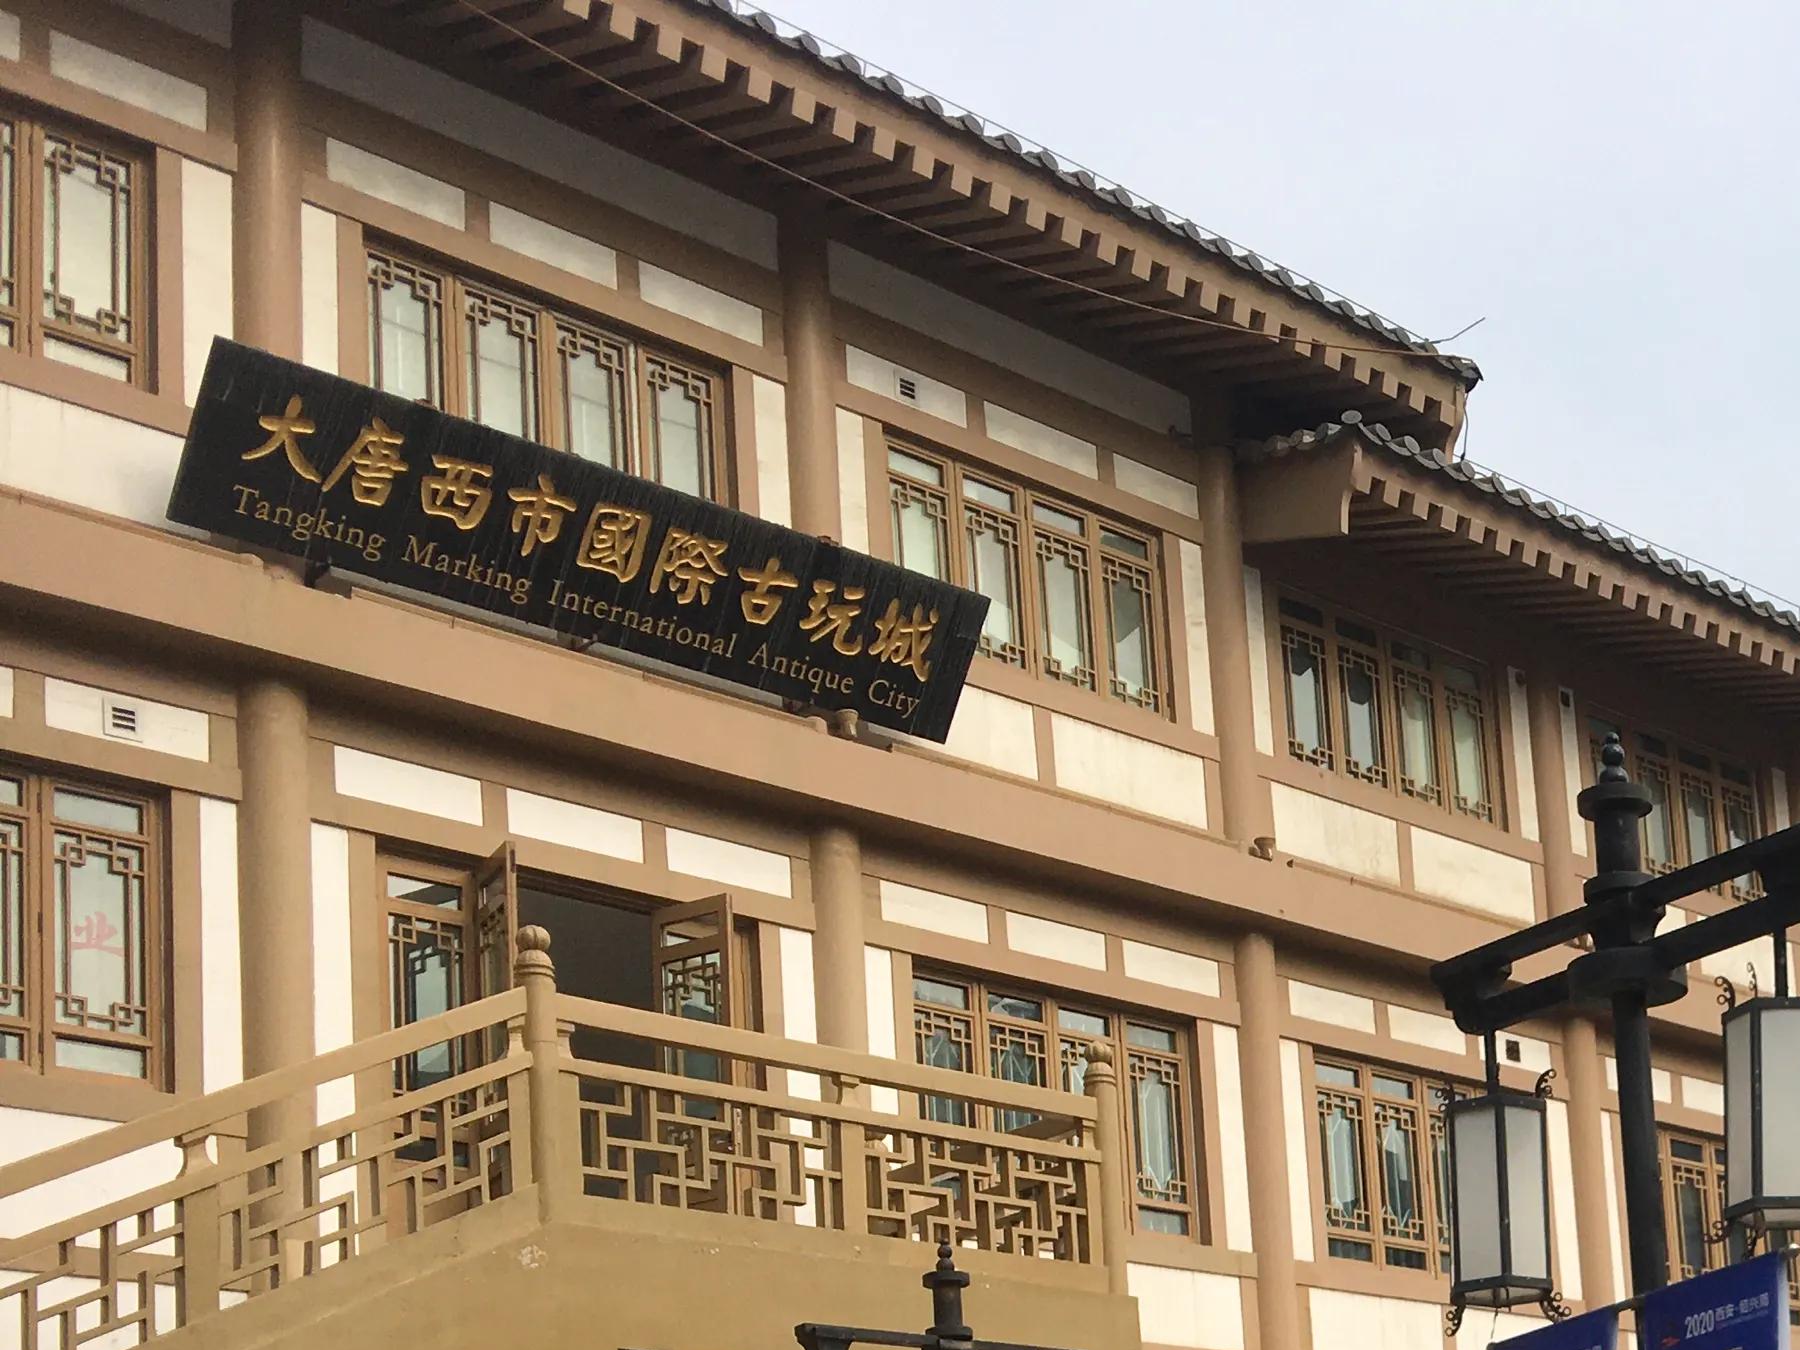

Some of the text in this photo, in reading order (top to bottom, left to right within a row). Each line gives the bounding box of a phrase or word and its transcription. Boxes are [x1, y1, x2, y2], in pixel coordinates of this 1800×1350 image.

[232, 484, 921, 719] Tangking Marking International Antique City
[241, 394, 939, 681] 大唐西市國際古玩城
